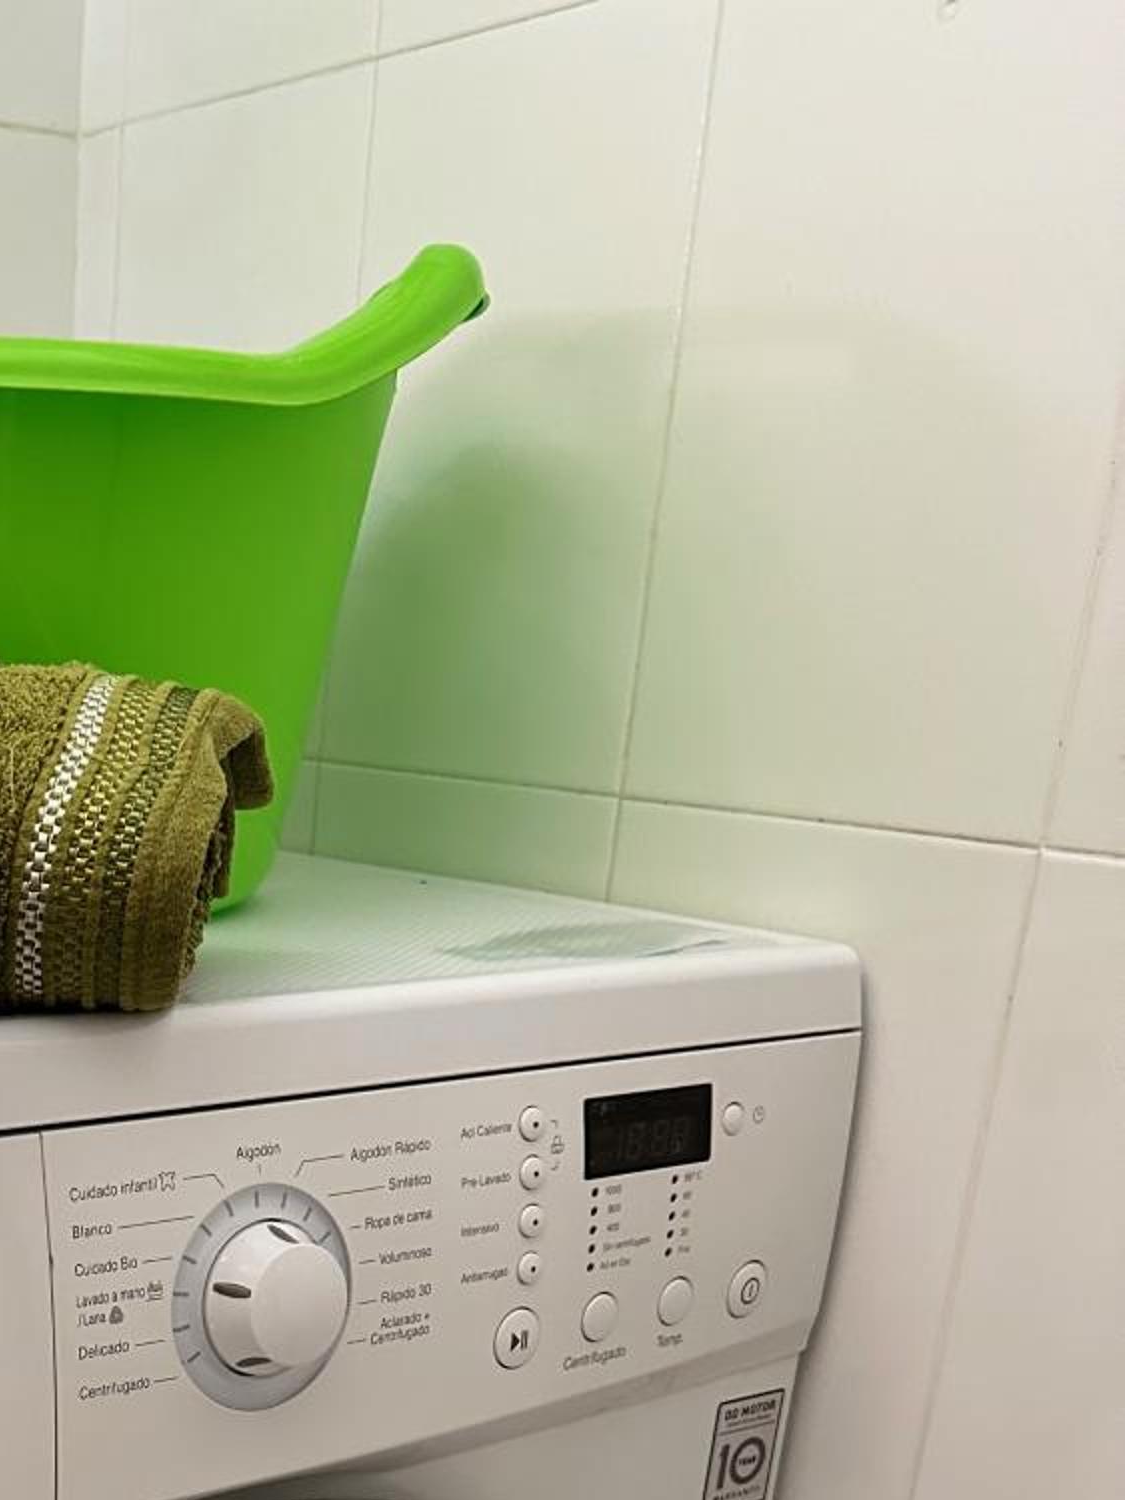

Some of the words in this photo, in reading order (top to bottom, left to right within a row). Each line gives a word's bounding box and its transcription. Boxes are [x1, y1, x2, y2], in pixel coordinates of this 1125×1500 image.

[69, 1183, 118, 1202] Cuidado
[120, 1177, 158, 1195] infantil
[364, 1216, 391, 1231] Ropa
[392, 1212, 406, 1227] de
[406, 1209, 433, 1224] cama
[72, 1223, 113, 1240] Blanco
[75, 1259, 118, 1277] Cuidado
[120, 1255, 138, 1271] Bio
[378, 1246, 432, 1265] Voluminoso
[76, 1291, 110, 1309] Lavado
[120, 1286, 146, 1301] mano
[418, 1282, 432, 1297] 30
[380, 1312, 423, 1329] Aclarado
[370, 1324, 431, 1345] Centrifugado
[78, 1340, 130, 1361] Delicado
[562, 1346, 627, 1371] Centrifugado
[78, 1376, 151, 1401] Centrifugado
